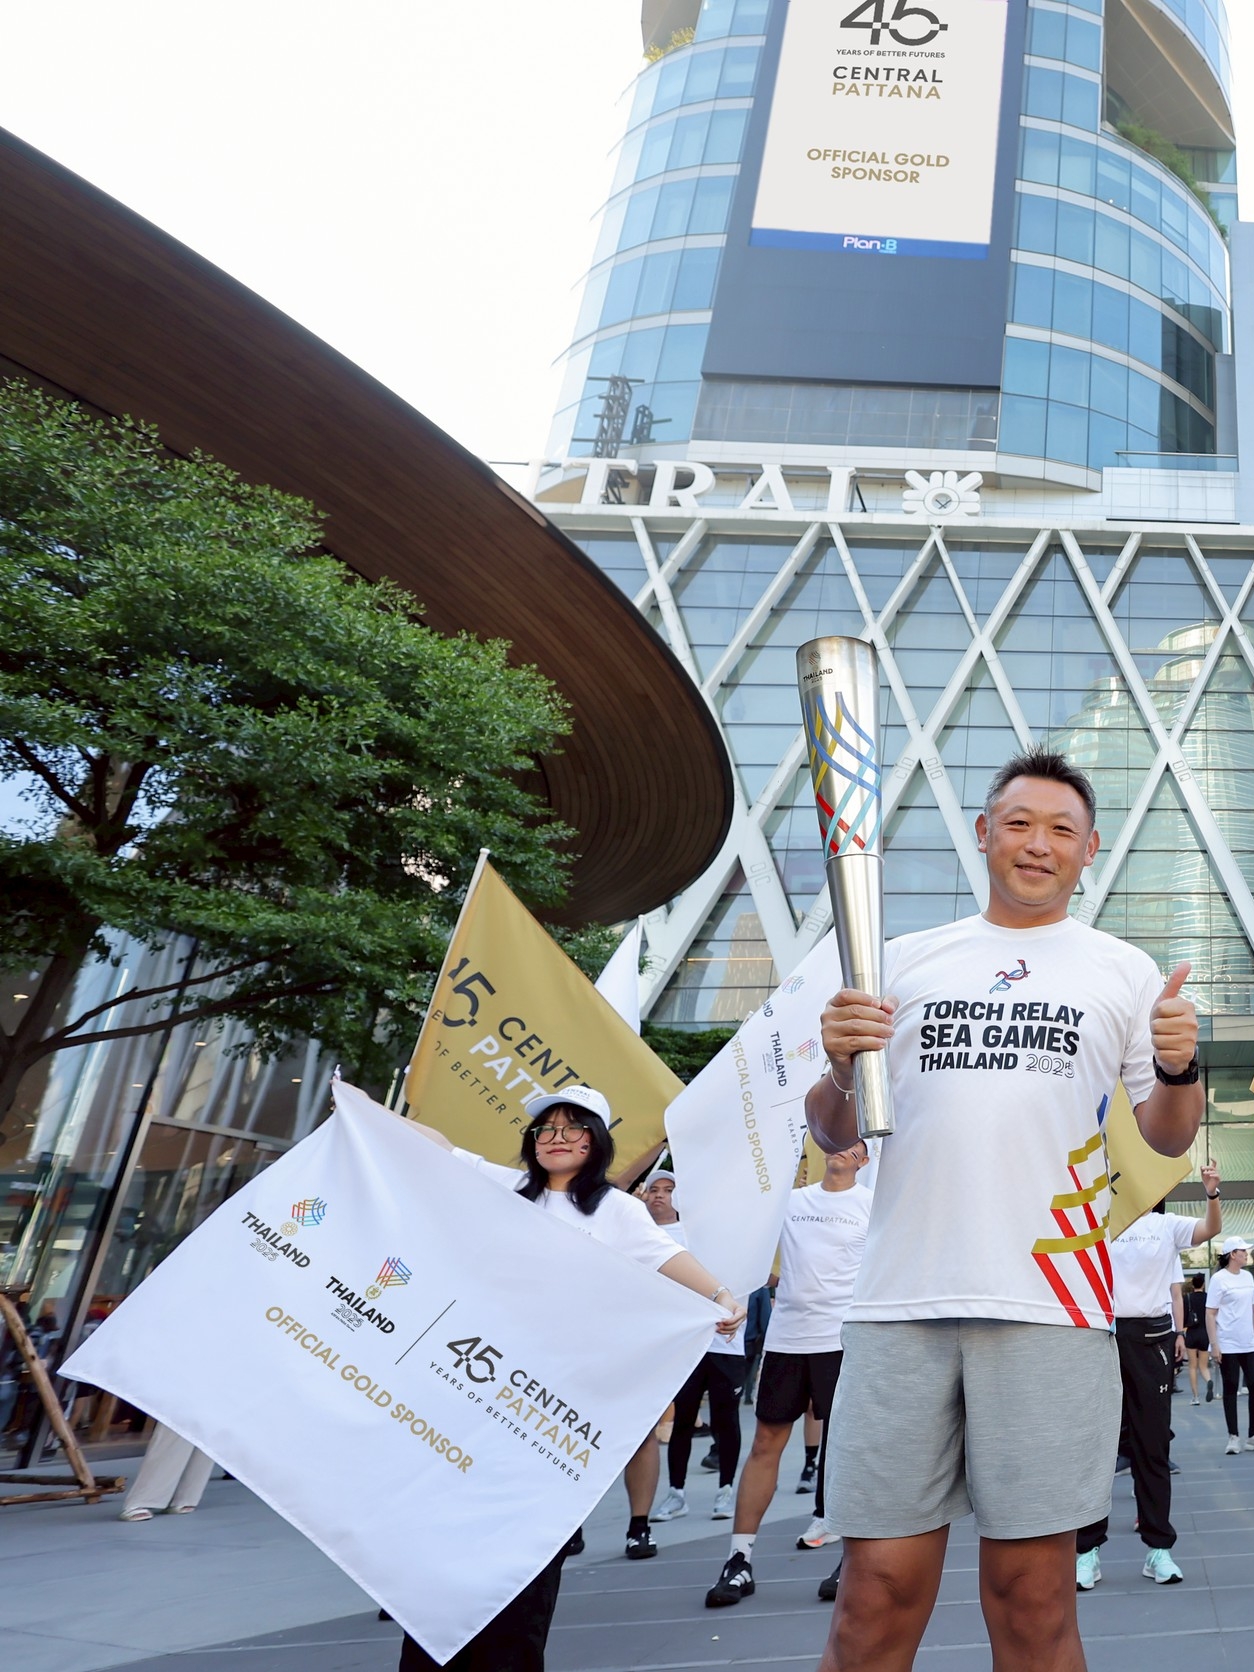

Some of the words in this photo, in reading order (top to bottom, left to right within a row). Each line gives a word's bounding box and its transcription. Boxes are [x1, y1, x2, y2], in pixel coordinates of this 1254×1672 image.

[840, 0, 948, 46] 45
[833, 66, 943, 83] CENTRAL
[836, 49, 862, 57] YEARS
[876, 50, 907, 58] BETTER
[908, 51, 946, 59] FUTURES
[832, 82, 941, 99] PATTANA
[807, 148, 889, 165] OFFICIAL
[894, 152, 950, 168] GOLD
[831, 166, 920, 184] SPONSOR
[923, 1000, 1005, 1021] TORCH
[1010, 1002, 1084, 1028] RELAY
[770, 1031, 787, 1087] THAILAND
[920, 1023, 972, 1049] SEA
[982, 1025, 1080, 1056] GAMES
[730, 1035, 751, 1090] OFFICIAL
[919, 1052, 1018, 1073] THAILAND
[1025, 1053, 1075, 1078] 2025
[450, 1061, 507, 1114] BETTER
[742, 1090, 758, 1134] GOLD
[787, 1117, 799, 1143] YEARS
[747, 1132, 772, 1194] SPONSOR
[241, 1211, 311, 1268] THAILAND
[249, 1238, 280, 1262] 2025
[325, 1276, 395, 1334] THAILAND
[334, 1303, 365, 1328] 2025
[446, 1336, 504, 1384] 45
[265, 1306, 341, 1371] OFFICIAL
[340, 1364, 393, 1408] GOLD
[390, 1403, 473, 1473] SPONSOR
[509, 1369, 602, 1450] CENTRAL
[429, 1361, 464, 1391] YEARS
[467, 1391, 483, 1405] OF
[485, 1405, 528, 1441] BETTER
[531, 1440, 581, 1482] FUTURES
[495, 1385, 591, 1468] PATTANA
